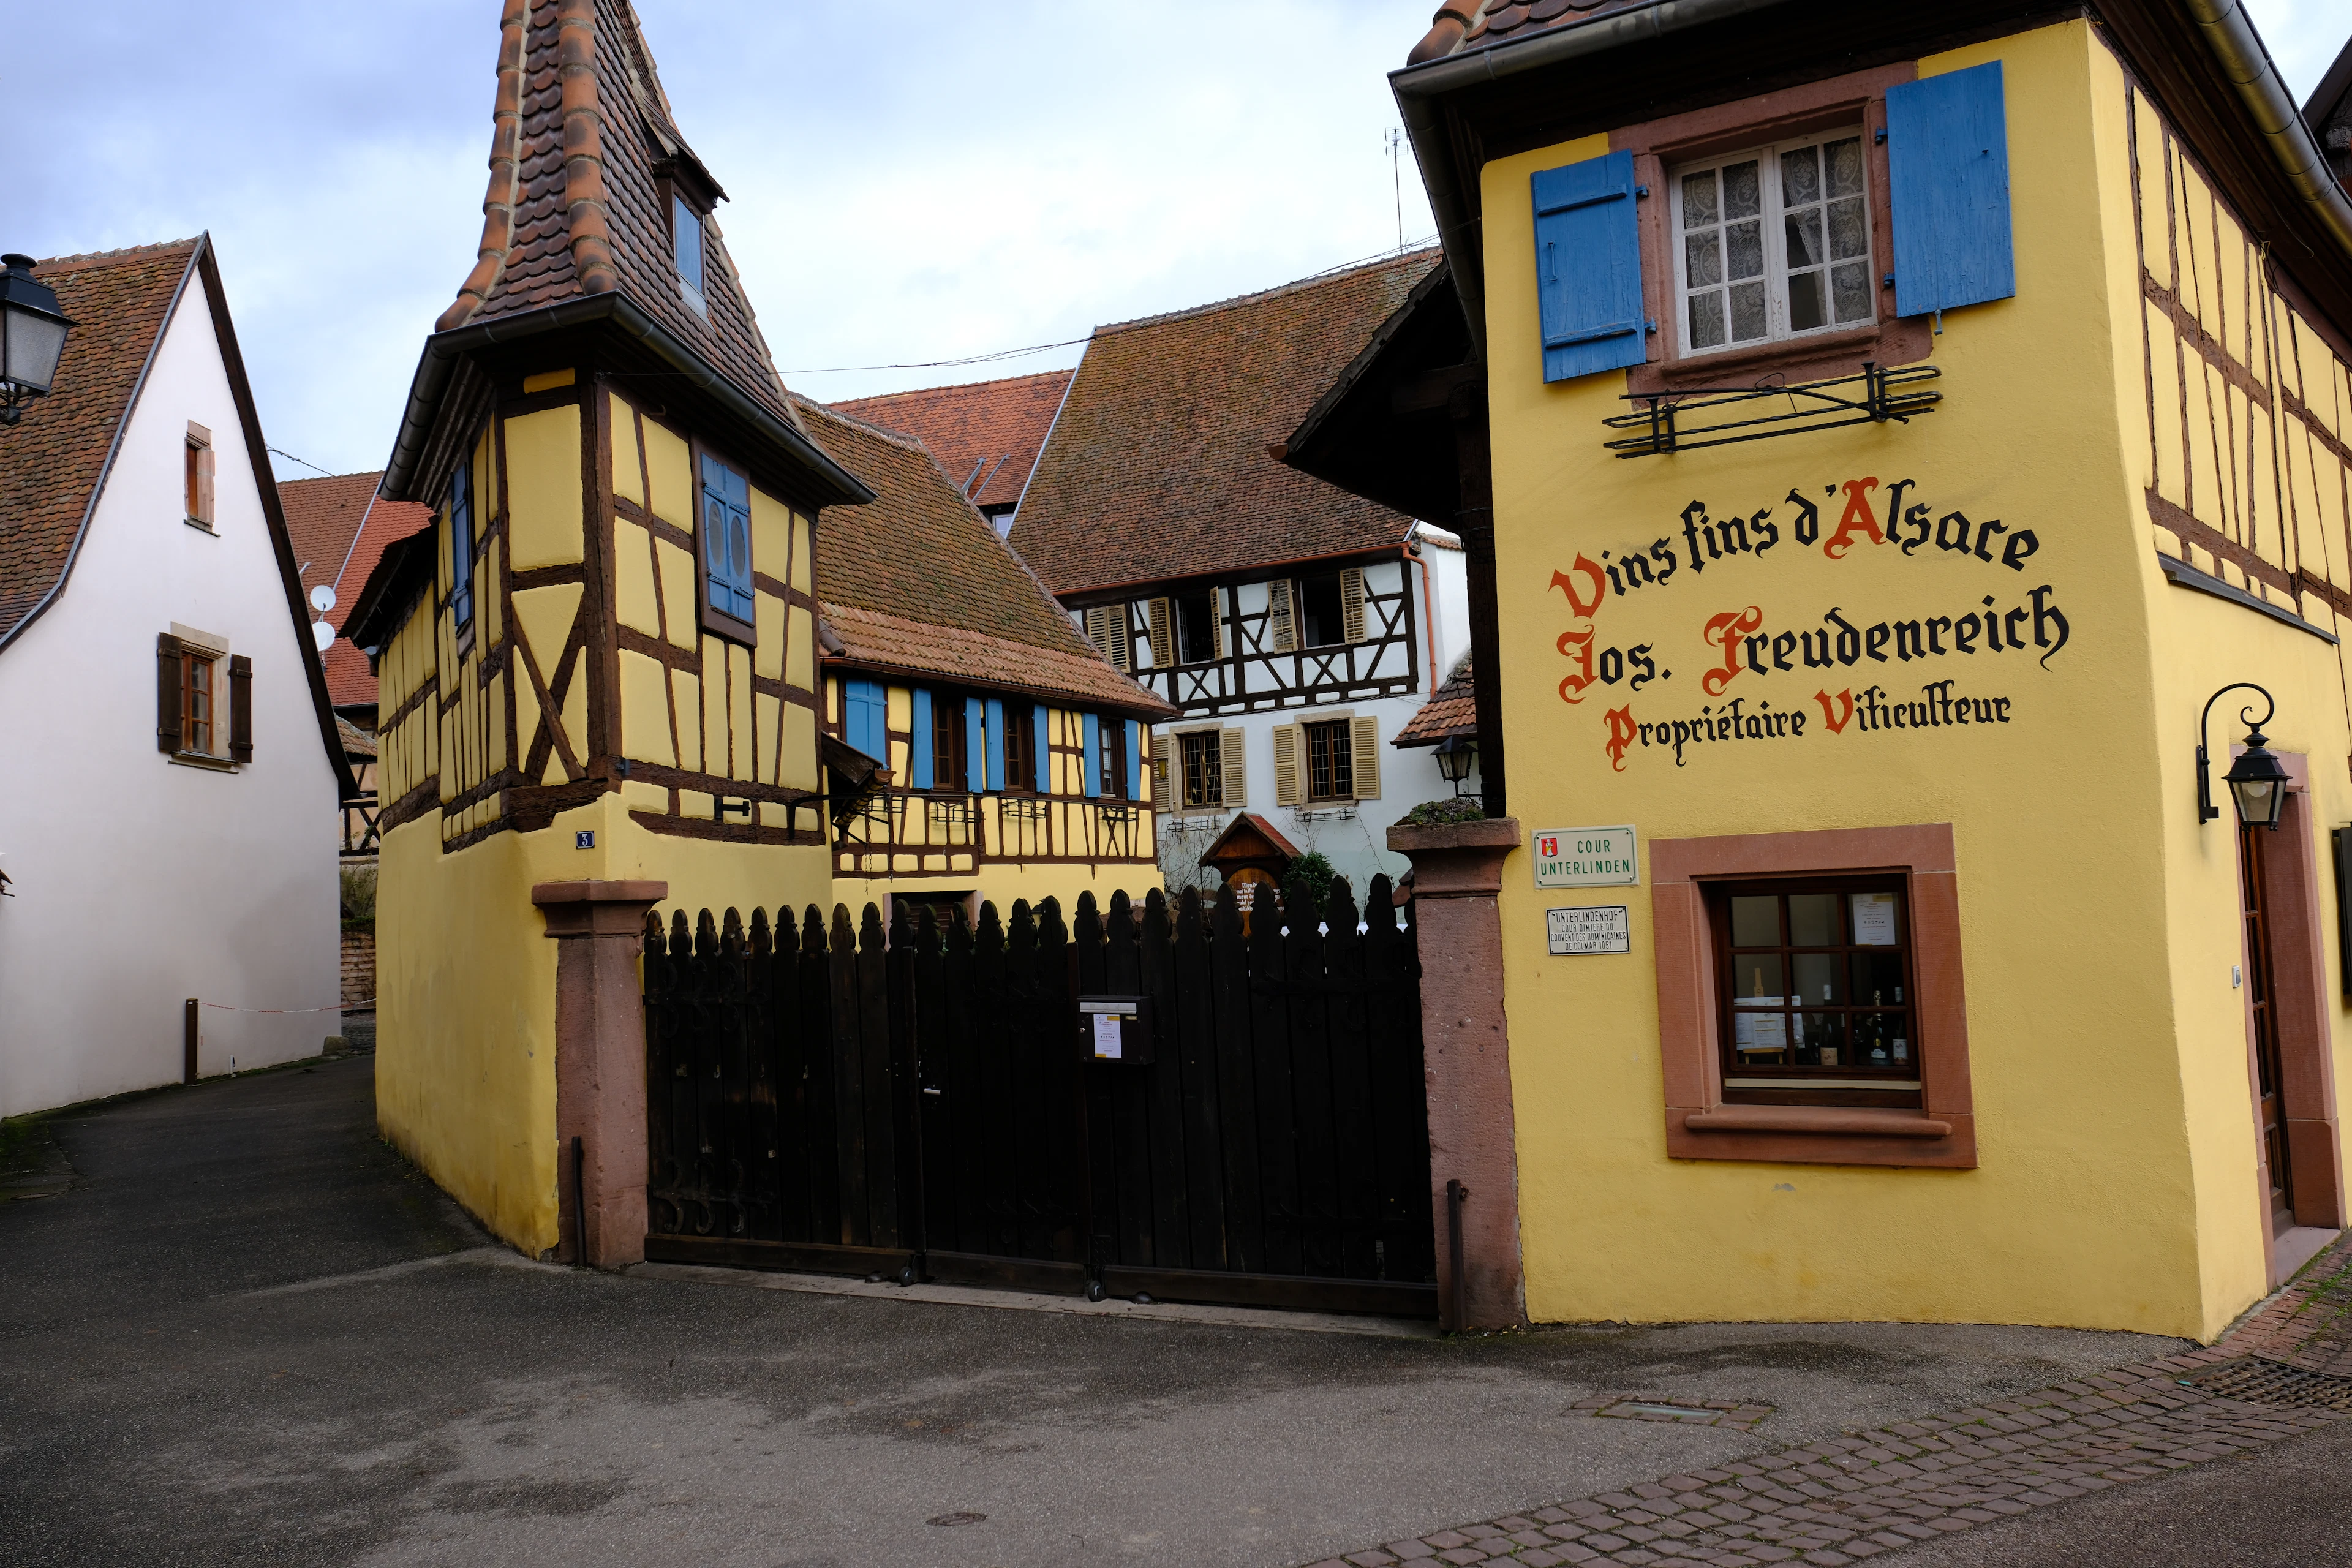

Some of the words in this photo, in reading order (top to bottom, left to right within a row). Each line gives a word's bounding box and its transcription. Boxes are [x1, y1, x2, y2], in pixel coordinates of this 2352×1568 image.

[1547, 537, 1678, 619] Vins
[1680, 499, 1779, 575] fins
[1785, 475, 2040, 571] d'Alsace
[1557, 624, 1672, 704] Jos.
[1702, 584, 2070, 697] Freudenreich
[1603, 697, 1806, 772] Propriétaire
[1812, 679, 2011, 735] Viticulteur
[581, 833, 589, 846] 3
[1577, 839, 1611, 853] COUR
[1540, 859, 1630, 875] UNTERLINDEN
[1561, 924, 1577, 932] COUR
[1606, 922, 1613, 931] DU
[1551, 933, 1574, 941] COUVENT
[1588, 931, 1626, 940] DOMINICAINES
[1566, 942, 1572, 951] DE
[1574, 941, 1597, 950] COLMAR
